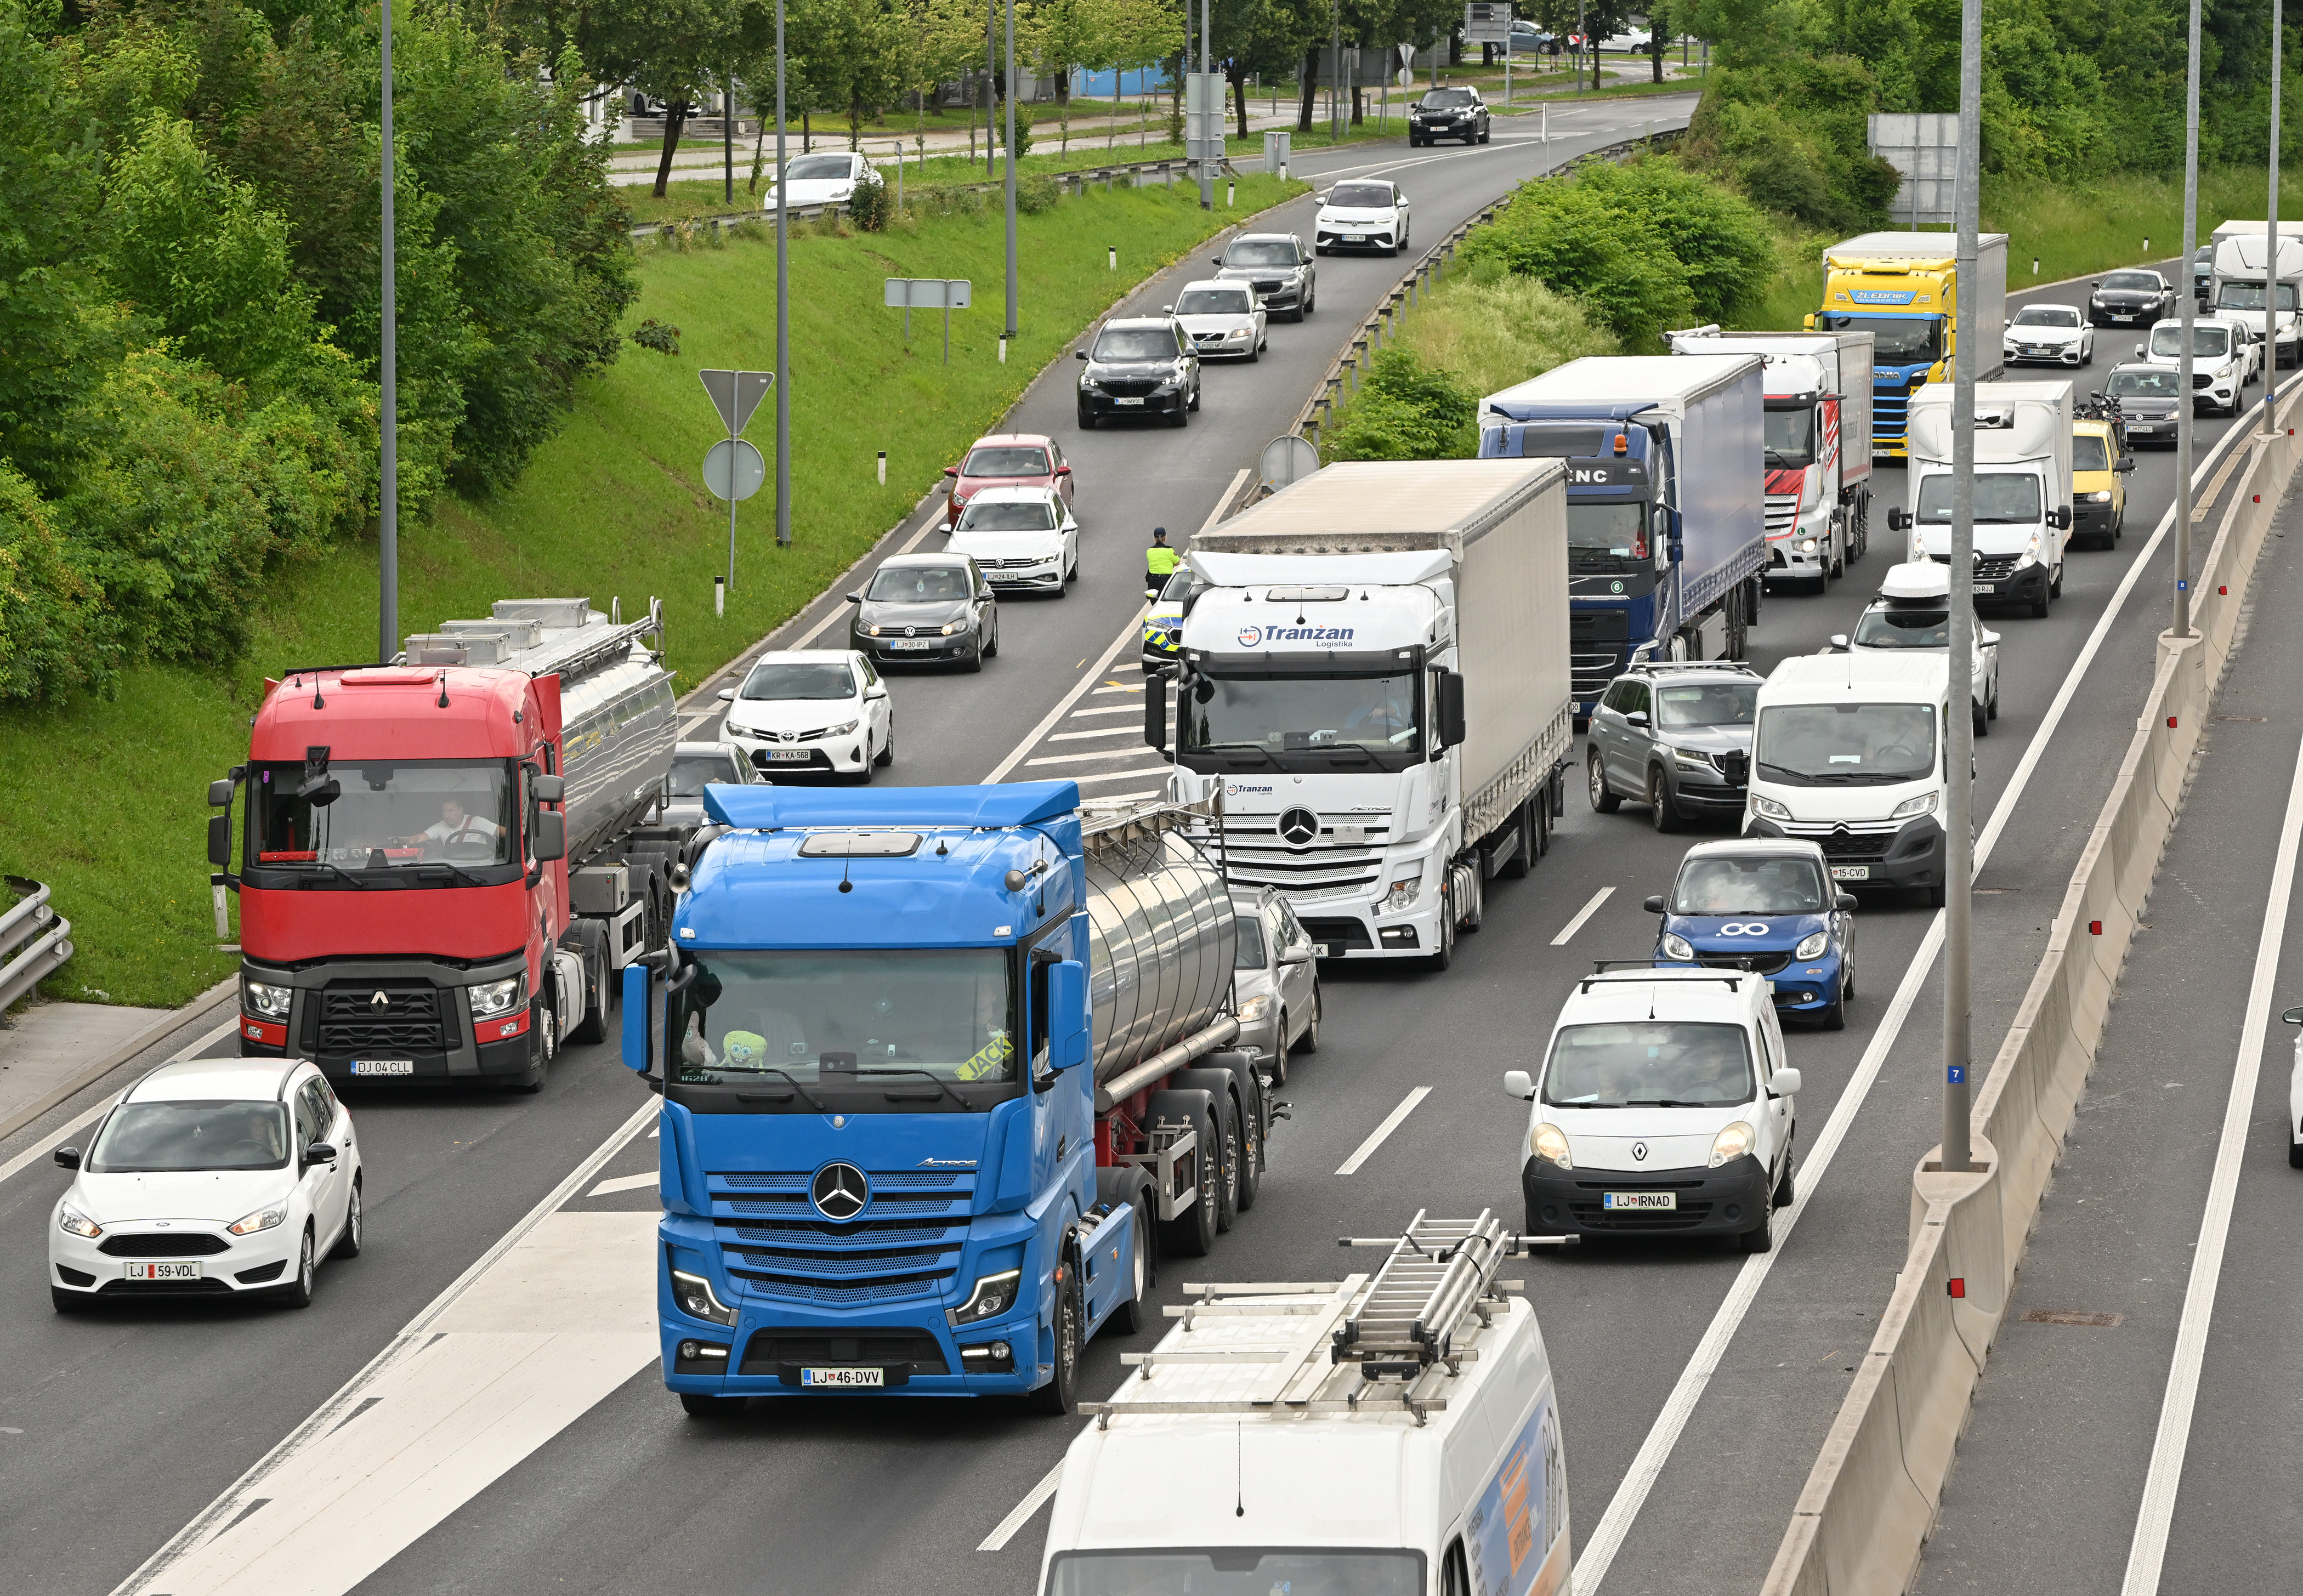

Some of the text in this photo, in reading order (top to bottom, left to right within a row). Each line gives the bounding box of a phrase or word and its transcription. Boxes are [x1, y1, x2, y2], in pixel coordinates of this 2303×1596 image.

[1856, 291, 1909, 300] ŽLEBNIK
[1614, 583, 1620, 591] 6
[1316, 640, 1353, 649] Logistika
[785, 751, 809, 759] KA-568
[1839, 868, 1865, 877] 15-CVD
[967, 1036, 1013, 1079] JACK
[358, 1063, 371, 1072] DJ
[375, 1063, 388, 1072] 04
[390, 1063, 410, 1072] CLL
[1953, 1070, 1959, 1078] 7
[1616, 1196, 1630, 1206] LJ
[1638, 1196, 1670, 1206] IRNAD
[131, 1265, 144, 1277] LJ
[158, 1265, 196, 1276] 59-VDL
[813, 1371, 827, 1383] LJ
[836, 1371, 879, 1383] 46-DVV
[1514, 1517, 1531, 1562] ENTRANCE
